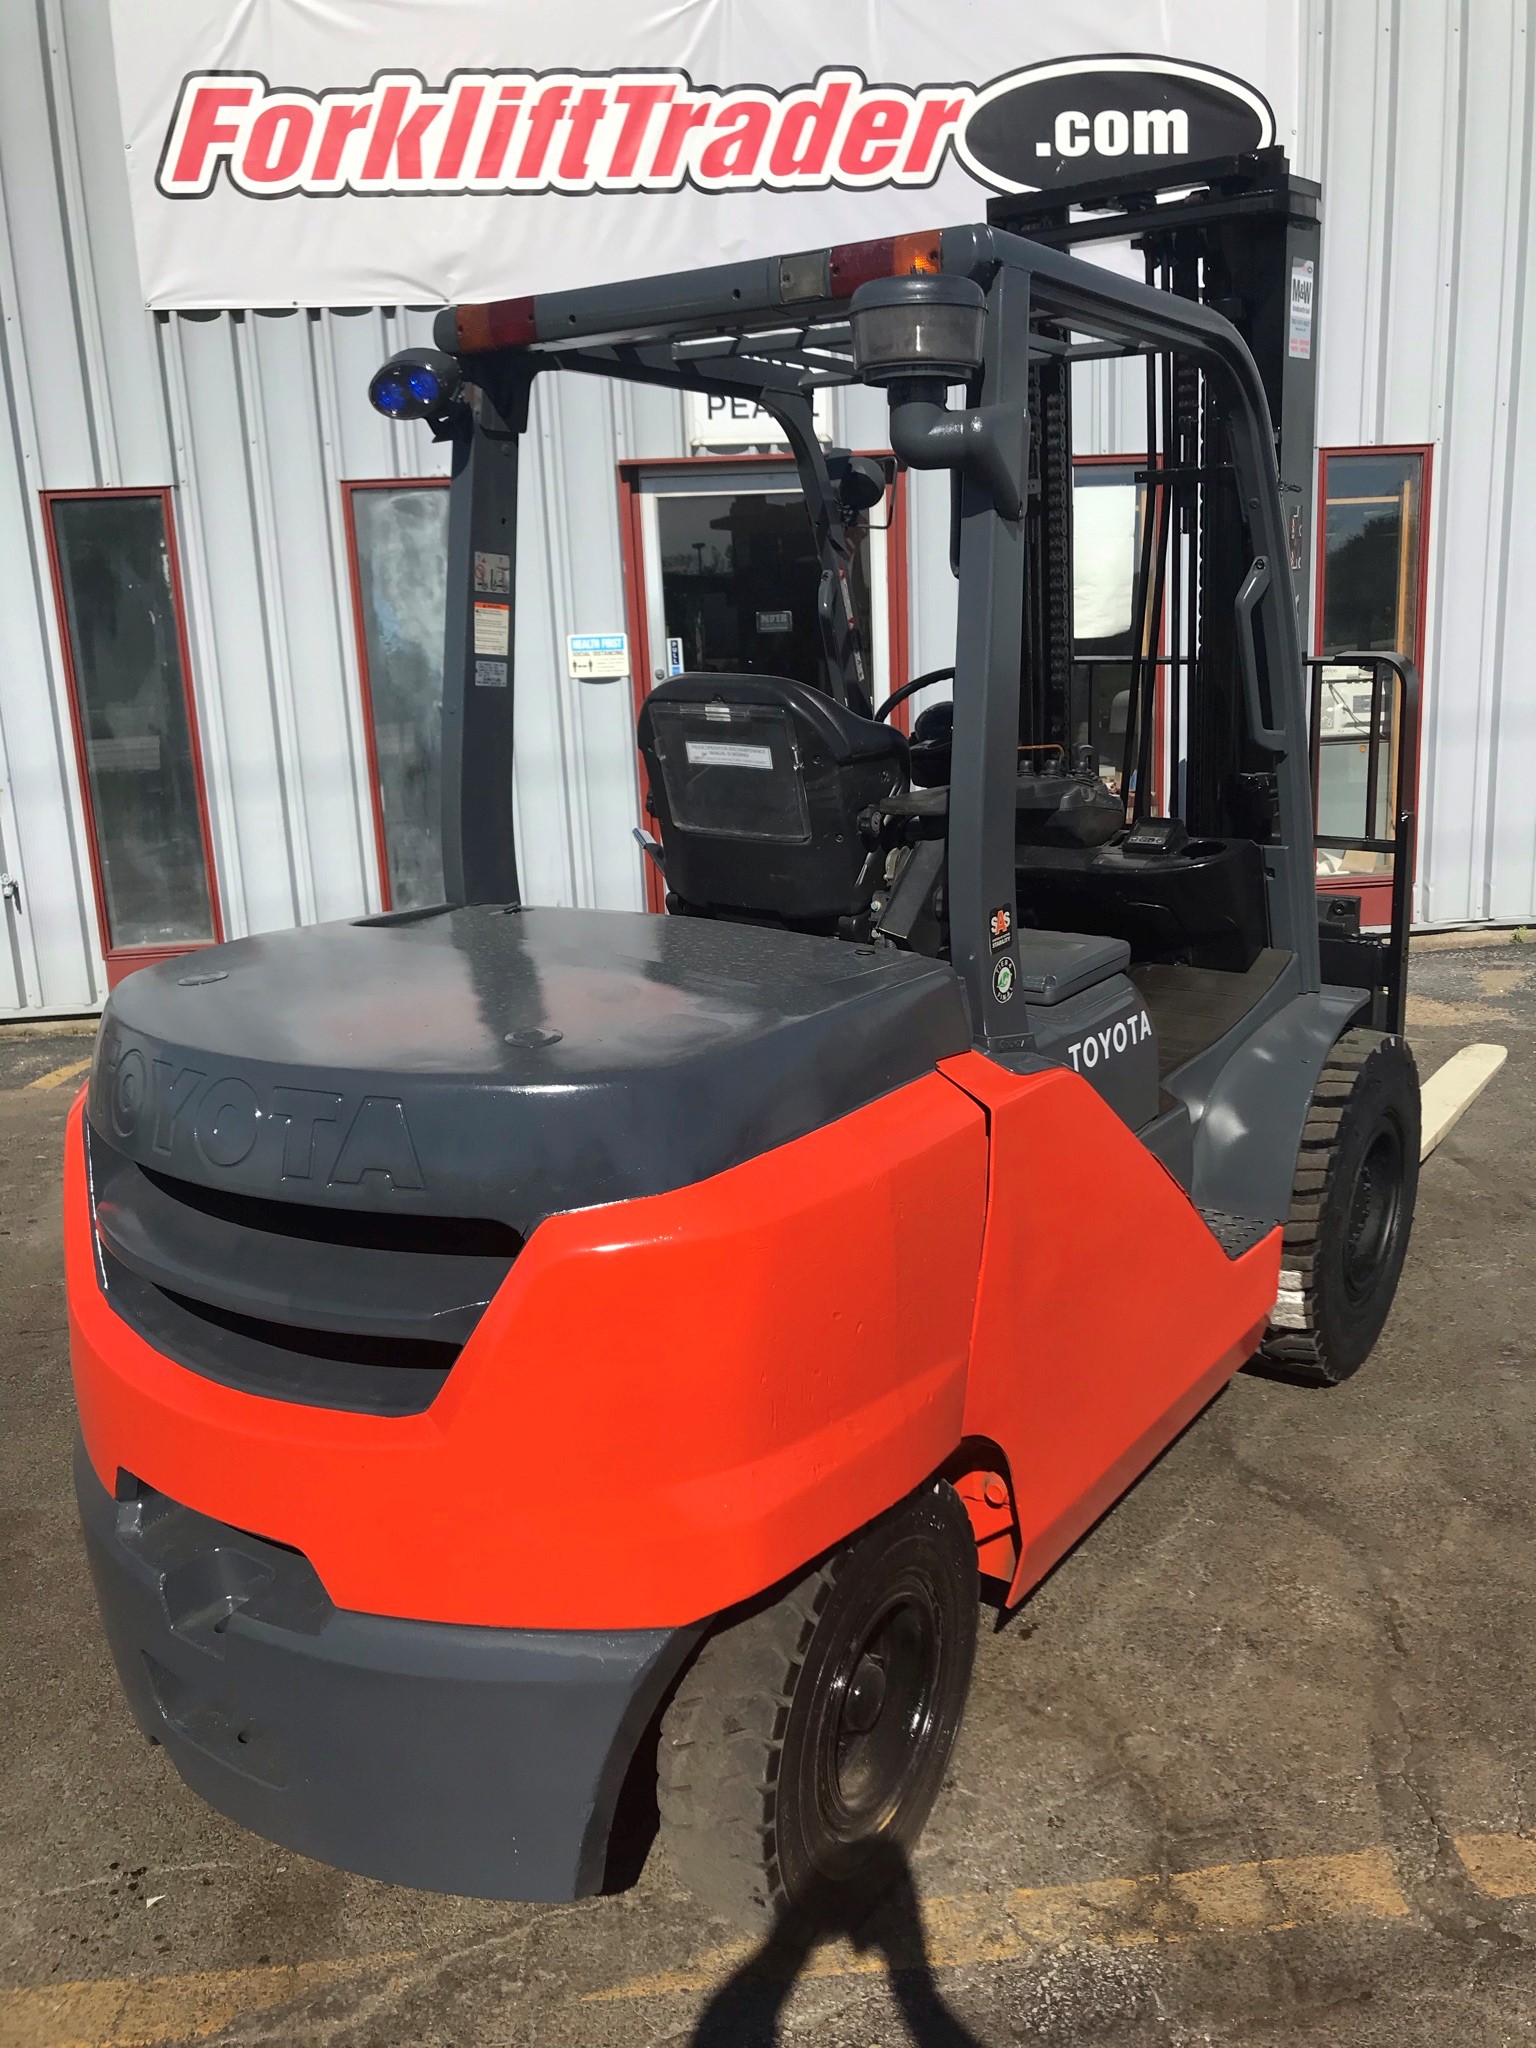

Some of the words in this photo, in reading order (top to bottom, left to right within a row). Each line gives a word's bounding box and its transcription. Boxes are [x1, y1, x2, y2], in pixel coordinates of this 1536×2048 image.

[1292, 278, 1312, 305] M&W
[991, 910, 1011, 935] SAS
[1067, 1010, 1152, 1073] TOYOTA
